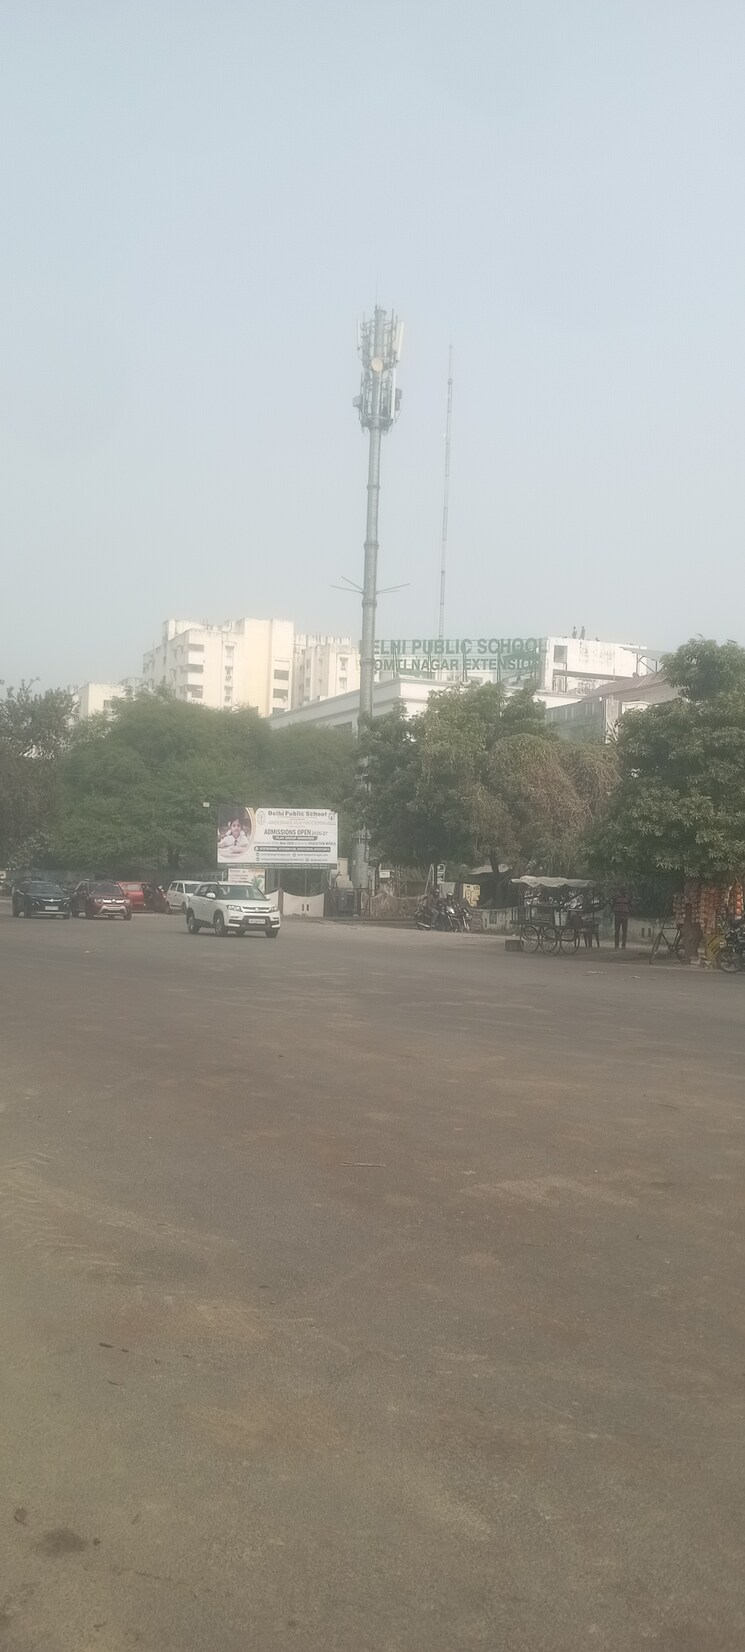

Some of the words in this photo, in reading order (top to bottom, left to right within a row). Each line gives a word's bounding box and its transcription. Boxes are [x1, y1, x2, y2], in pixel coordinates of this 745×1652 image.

[412, 638, 472, 654] PUBLIC
[477, 637, 547, 654] SCHOOL
[412, 659, 459, 671] NAGAR
